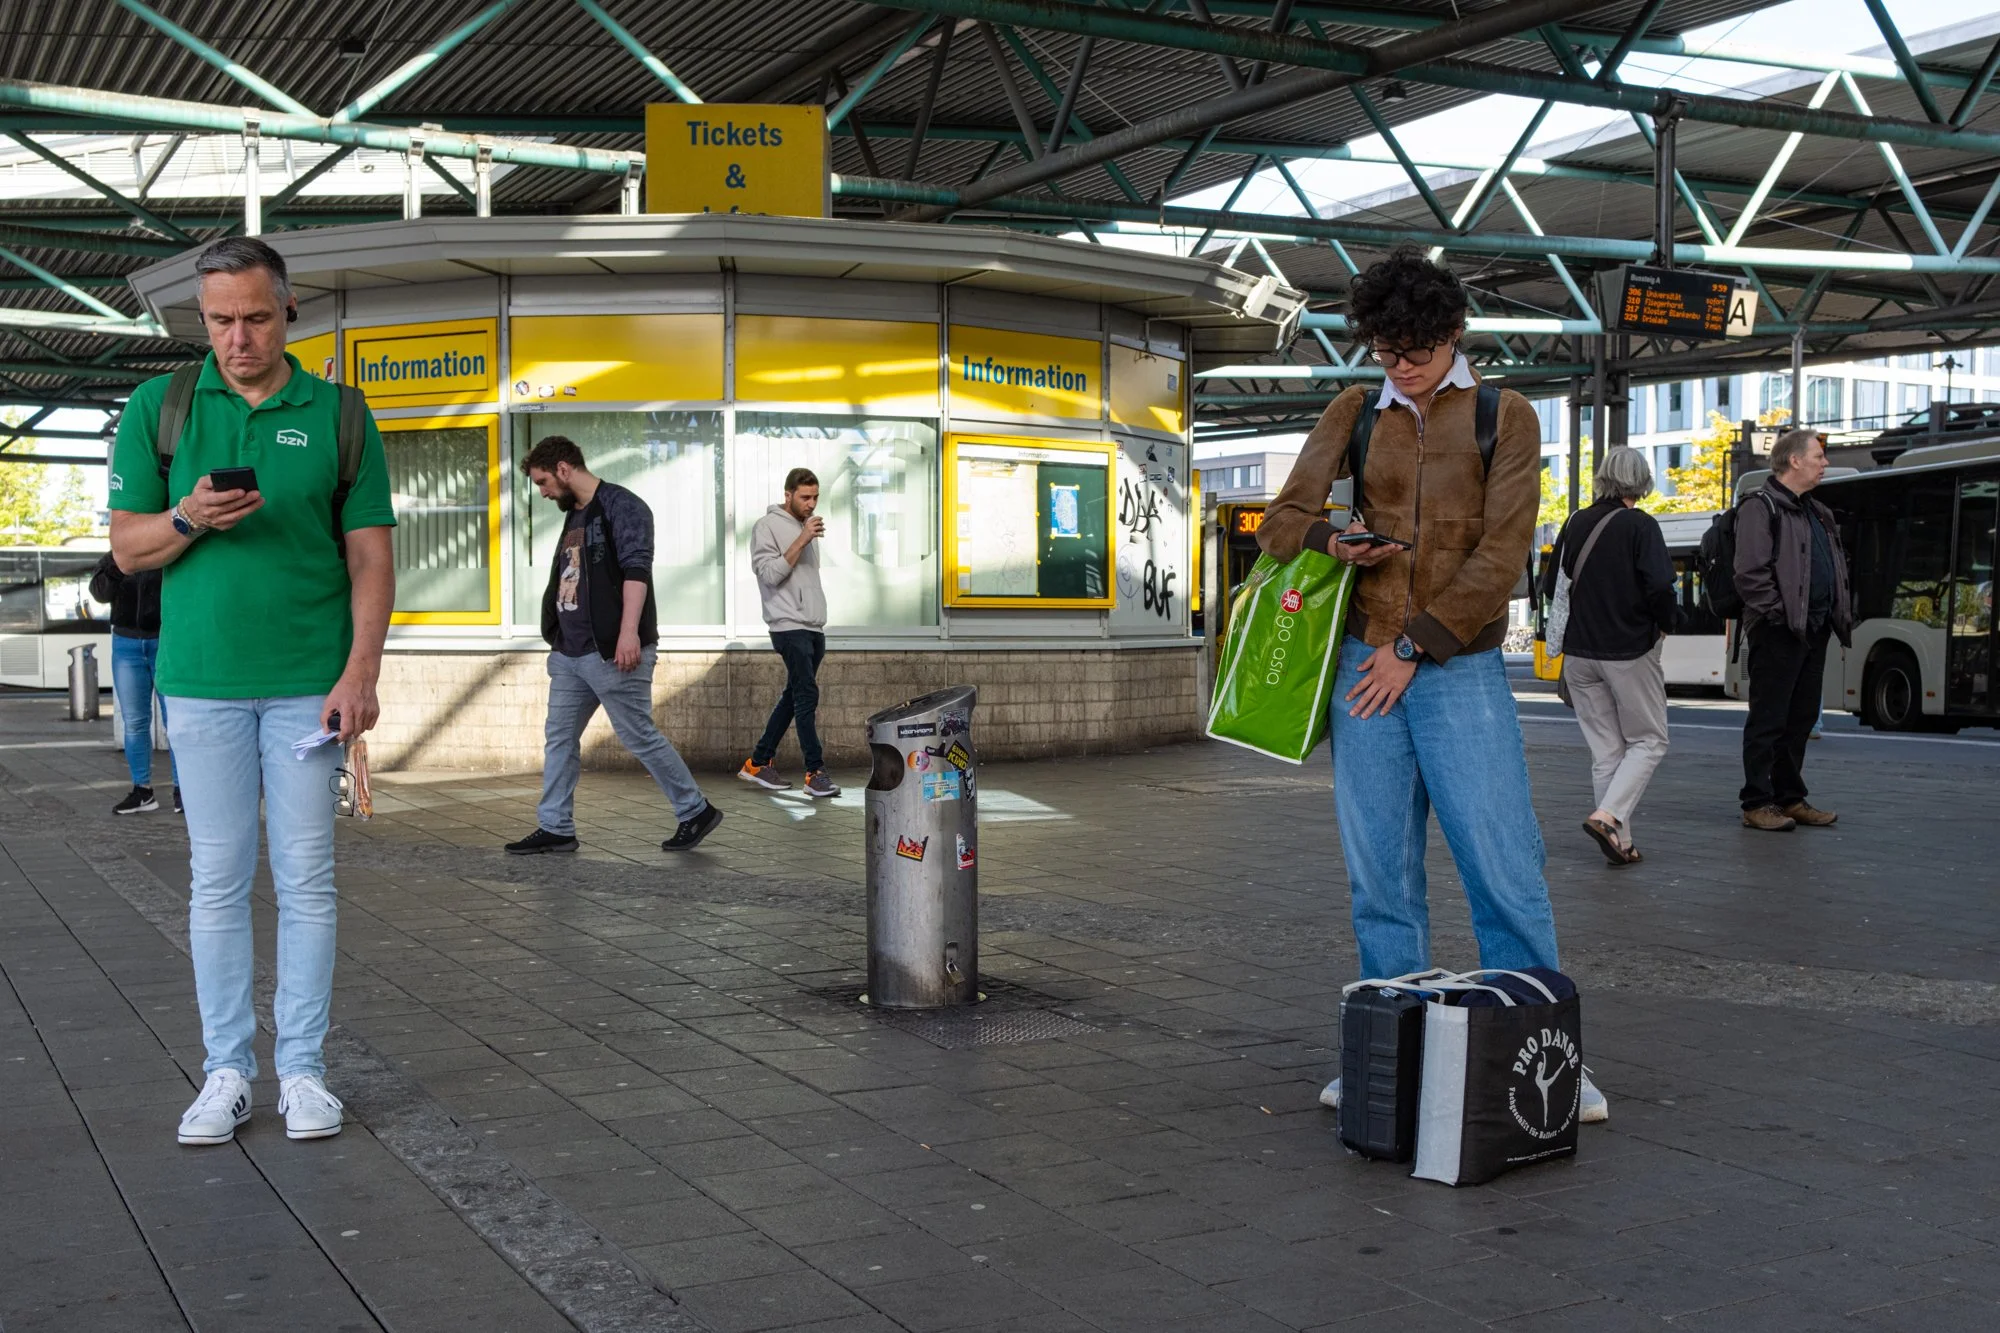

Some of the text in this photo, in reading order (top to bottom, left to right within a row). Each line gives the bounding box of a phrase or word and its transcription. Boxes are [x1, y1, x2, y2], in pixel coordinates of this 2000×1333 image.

[686, 120, 783, 146] Tickets
[725, 163, 746, 189] &
[1656, 276, 1661, 284] A
[1626, 296, 1641, 304] 310
[1628, 288, 1642, 296] 306
[1706, 298, 1726, 306] sofort
[1624, 312, 1638, 321] 329
[1625, 304, 1640, 312] 317
[1727, 297, 1747, 326] A
[359, 348, 486, 384] Information
[963, 354, 1087, 392] Information
[1763, 436, 1773, 451] E
[1017, 451, 1050, 459] Information
[1284, 591, 1300, 610] 東
[1266, 615, 1294, 685] go asia
[947, 753, 968, 771] KIND
[897, 840, 924, 857] NZS
[1512, 1028, 1580, 1076] PRO DANSE
[1528, 1126, 1539, 1138] für
